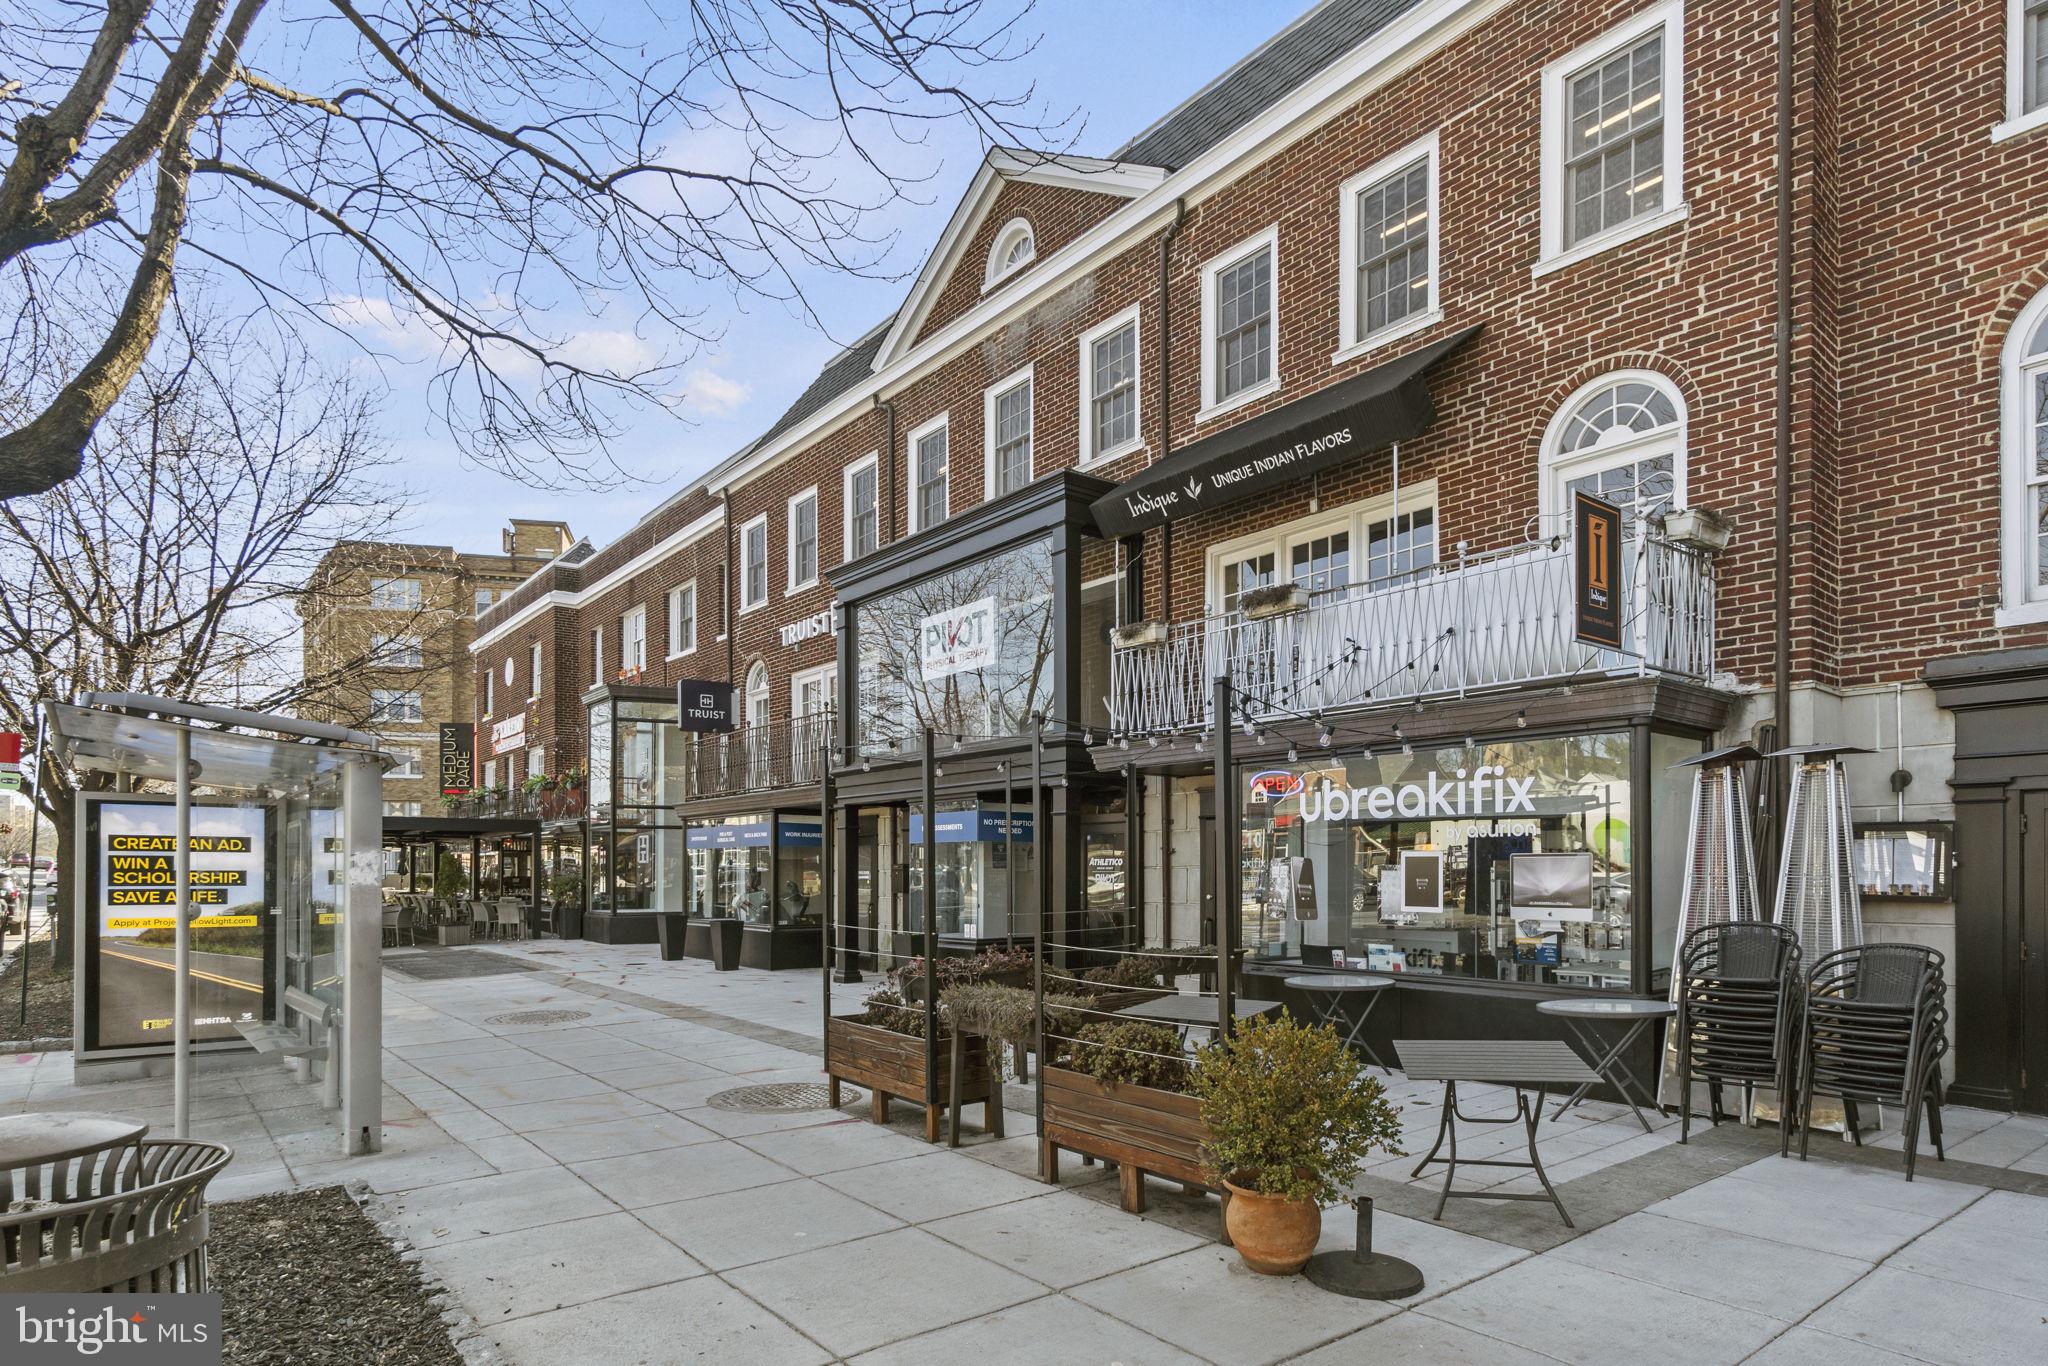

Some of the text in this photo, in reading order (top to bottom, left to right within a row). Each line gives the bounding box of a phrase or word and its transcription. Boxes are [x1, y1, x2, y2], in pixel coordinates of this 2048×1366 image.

[1125, 428, 1352, 517] Indique UNIQUE INDIAN FLAVORS
[780, 611, 832, 646] TRUIST
[926, 608, 988, 657] PIVOT
[687, 708, 726, 719] TRUIST
[442, 728, 456, 787] MEDIUM
[457, 751, 470, 787] RARE
[1300, 765, 1537, 823] ubreakifix
[1446, 823, 1537, 841] by asurion
[189, 838, 212, 850] AN
[217, 839, 246, 851] AD.
[113, 857, 168, 869] WIN A
[1089, 857, 1123, 866] ATHLETICO
[113, 872, 241, 884] SCHOLRSHIP.
[113, 890, 222, 903] SAVE A IFE.
[113, 918, 139, 928] Apply
